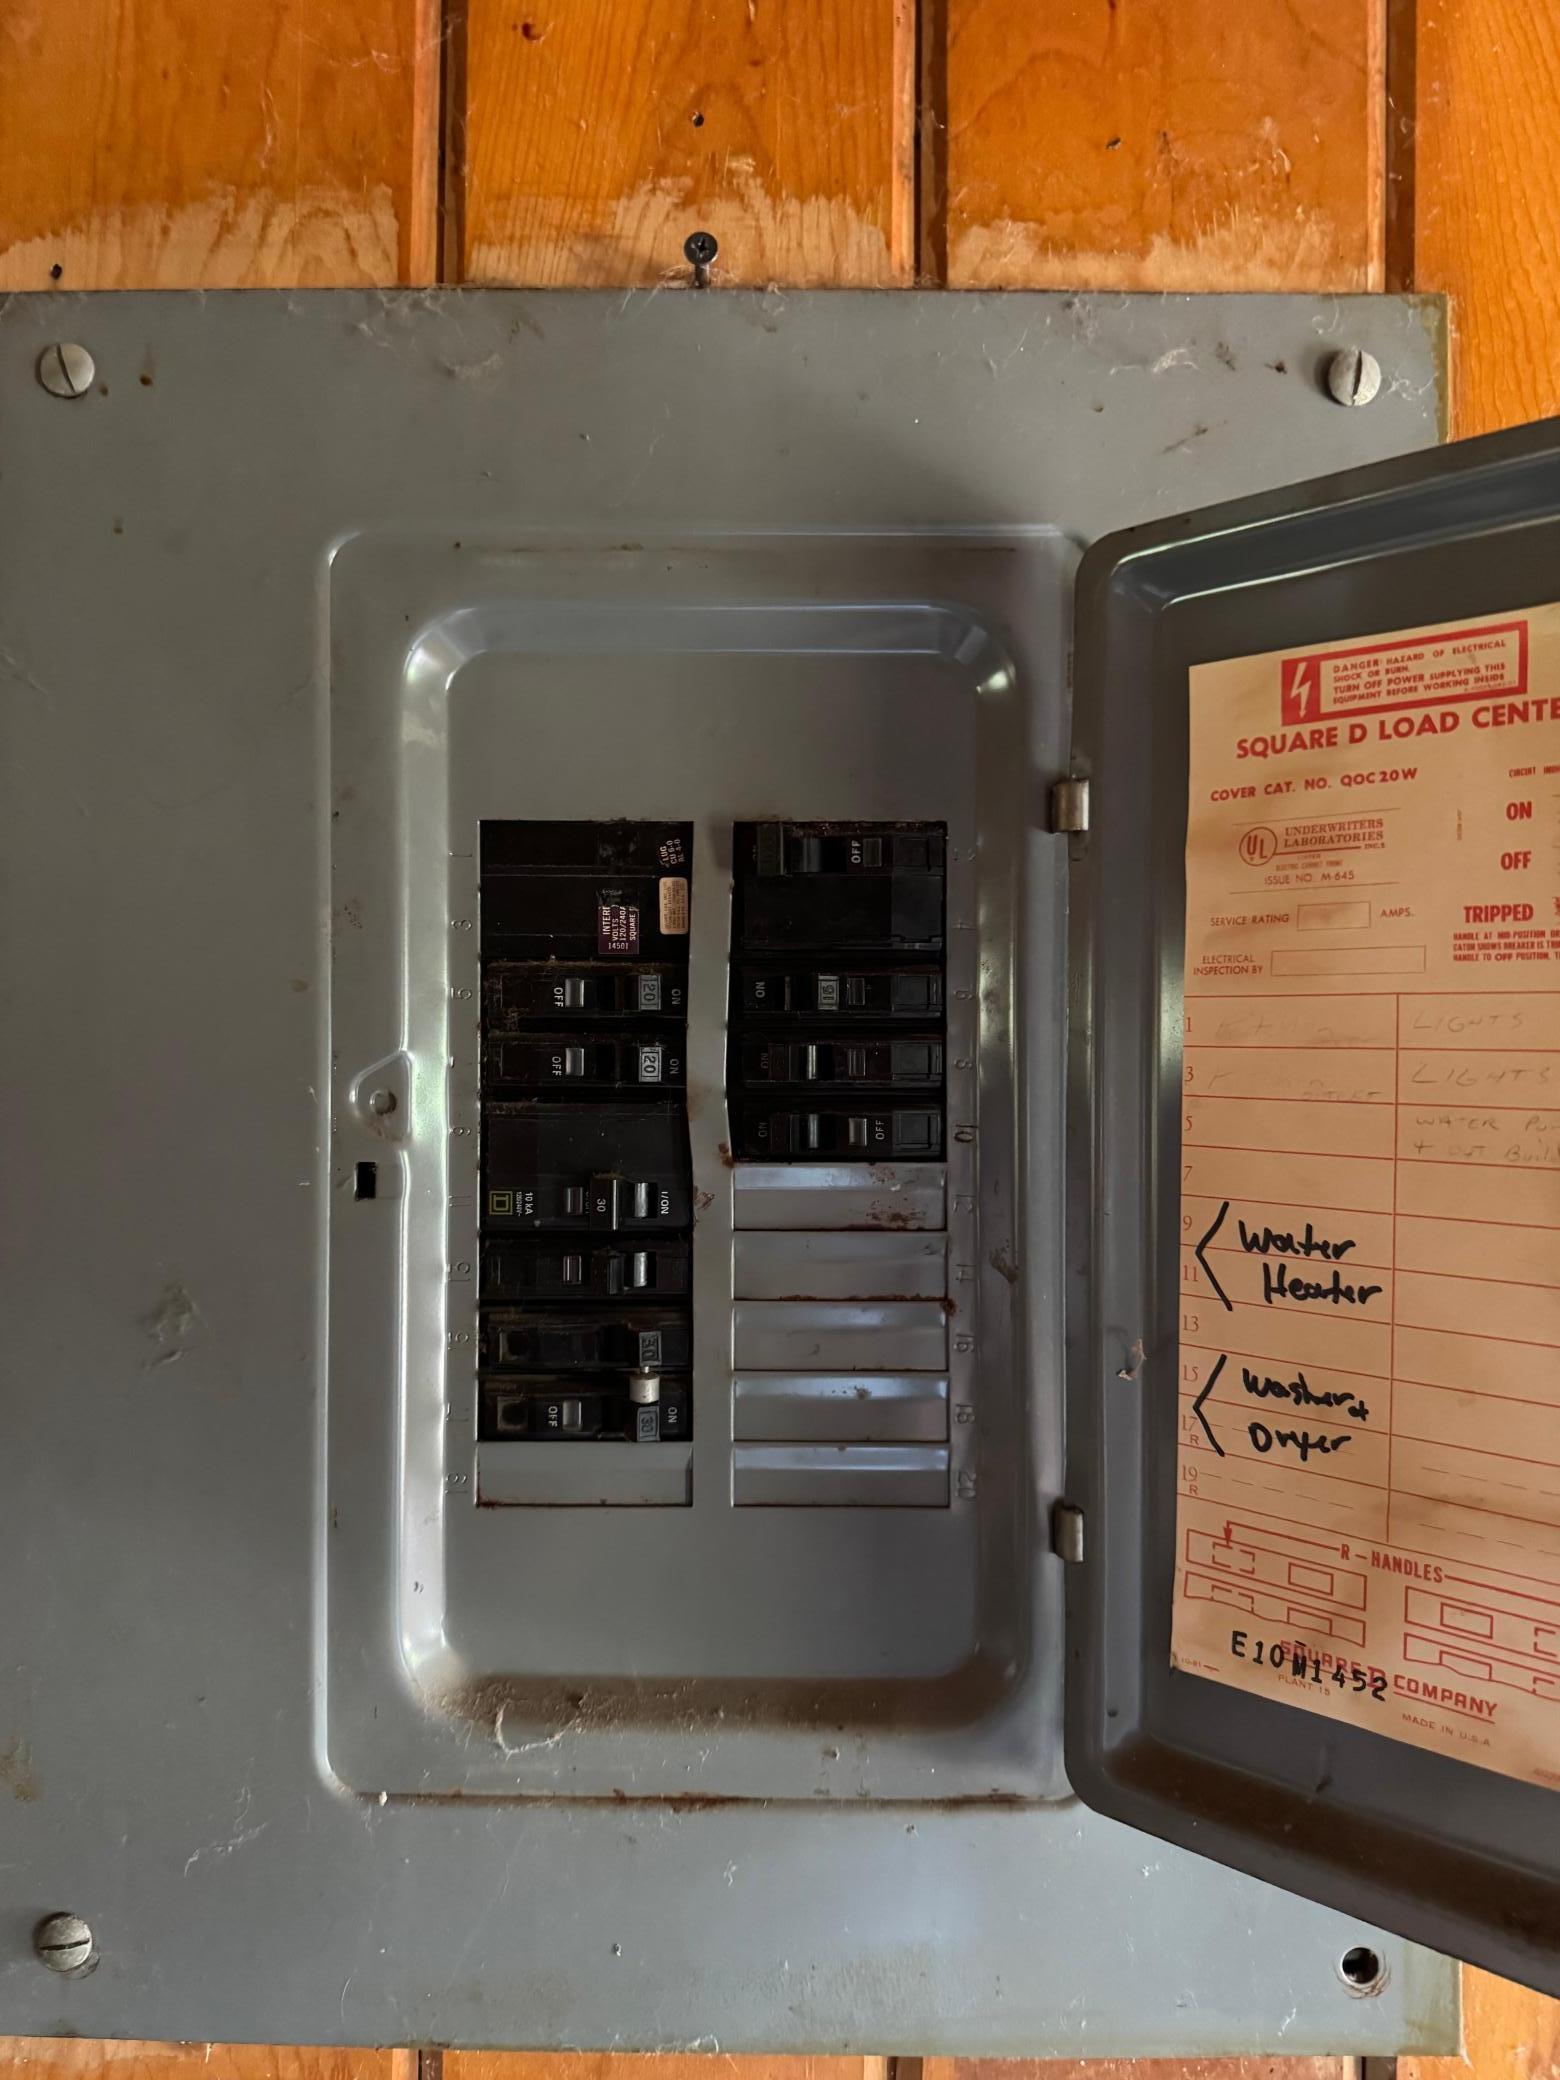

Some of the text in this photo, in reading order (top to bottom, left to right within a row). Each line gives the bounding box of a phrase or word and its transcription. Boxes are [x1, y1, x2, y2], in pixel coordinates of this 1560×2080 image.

[1386, 653, 1424, 665] HAZARD
[1433, 650, 1444, 658] OF
[1453, 640, 1506, 655] ELECTRICAL
[1333, 673, 1361, 683] SHOCK
[1367, 670, 1380, 678] OR
[1333, 662, 1506, 695] TURN OFF POWER SUPPLYING THIS
[1333, 691, 1382, 705] EQUIPMENT
[1386, 686, 1419, 696] BEFORE
[1423, 679, 1469, 691] WORKING
[1474, 674, 1505, 684] INSIDE
[1236, 726, 1339, 760] SQUARE
[1349, 723, 1368, 745] D
[1378, 711, 1460, 741] LOAD
[1509, 766, 1536, 778] CIRCUIT
[1211, 786, 1257, 802] COVER
[1264, 783, 1296, 795] CAT.
[1304, 778, 1332, 790] NO.
[1506, 800, 1533, 821] ON
[1285, 818, 1384, 837] UNDERWRITERS
[1246, 834, 1267, 860] UL
[1283, 831, 1384, 848] LABORATORIES
[660, 846, 669, 862] LUG
[850, 839, 863, 864] OFF
[1500, 850, 1532, 870] OFF
[1264, 874, 1290, 885] ISSUE
[1210, 914, 1290, 927] SERVICE RATING
[1380, 907, 1414, 918] AMPS.
[1464, 903, 1534, 924] TRIPPED
[629, 913, 637, 941] SQUARE
[1453, 932, 1479, 941] HANDLE
[1483, 932, 1492, 940] AT
[1453, 943, 1475, 952] CATOR
[1477, 942, 1502, 951] SHOWS
[1504, 941, 1535, 950] BREAKER
[1537, 941, 1544, 949] IS
[1202, 954, 1255, 965] ELECTRICAL
[1453, 953, 1479, 961] HANDLE
[1483, 952, 1492, 961] TO
[1495, 953, 1513, 962] OFF
[1193, 966, 1263, 976] INSPECTION BY
[553, 983, 682, 1008] OFF 20 ON
[754, 981, 766, 999] ON
[1185, 1017, 1193, 1033] 1
[1412, 1009, 1524, 1033] LIGHTS
[551, 1055, 680, 1077] OFF 20 ON
[1184, 1066, 1194, 1082] 3
[1410, 1062, 1551, 1087] LIGHTS
[757, 1119, 886, 1141] ON OFF
[1184, 1115, 1193, 1131] 5
[953, 1123, 979, 1144] 10
[1183, 1166, 1193, 1182] 7
[596, 1197, 607, 1213] 30
[1182, 1215, 1193, 1231] 9
[1238, 1219, 1356, 1260] Water
[1183, 1265, 1199, 1282] 11
[1262, 1262, 1383, 1305] Heater
[1182, 1315, 1199, 1332] 13
[1183, 1365, 1199, 1382] 15
[1242, 1367, 1355, 1408] Washer
[547, 1404, 559, 1429] OFF
[667, 1406, 678, 1424] ON
[1182, 1415, 1198, 1432] 17
[1189, 1434, 1200, 1446] R
[1247, 1422, 1353, 1462] Dryer
[1181, 1465, 1199, 1481] 19
[1189, 1485, 1199, 1496] R
[1340, 1543, 1350, 1561] R
[1371, 1550, 1444, 1584] HANDLES
[1278, 1674, 1314, 1691] PLANT
[1393, 1673, 1498, 1717] COMPANY
[1402, 1713, 1437, 1730] MADE
[1441, 1725, 1454, 1736] IN
